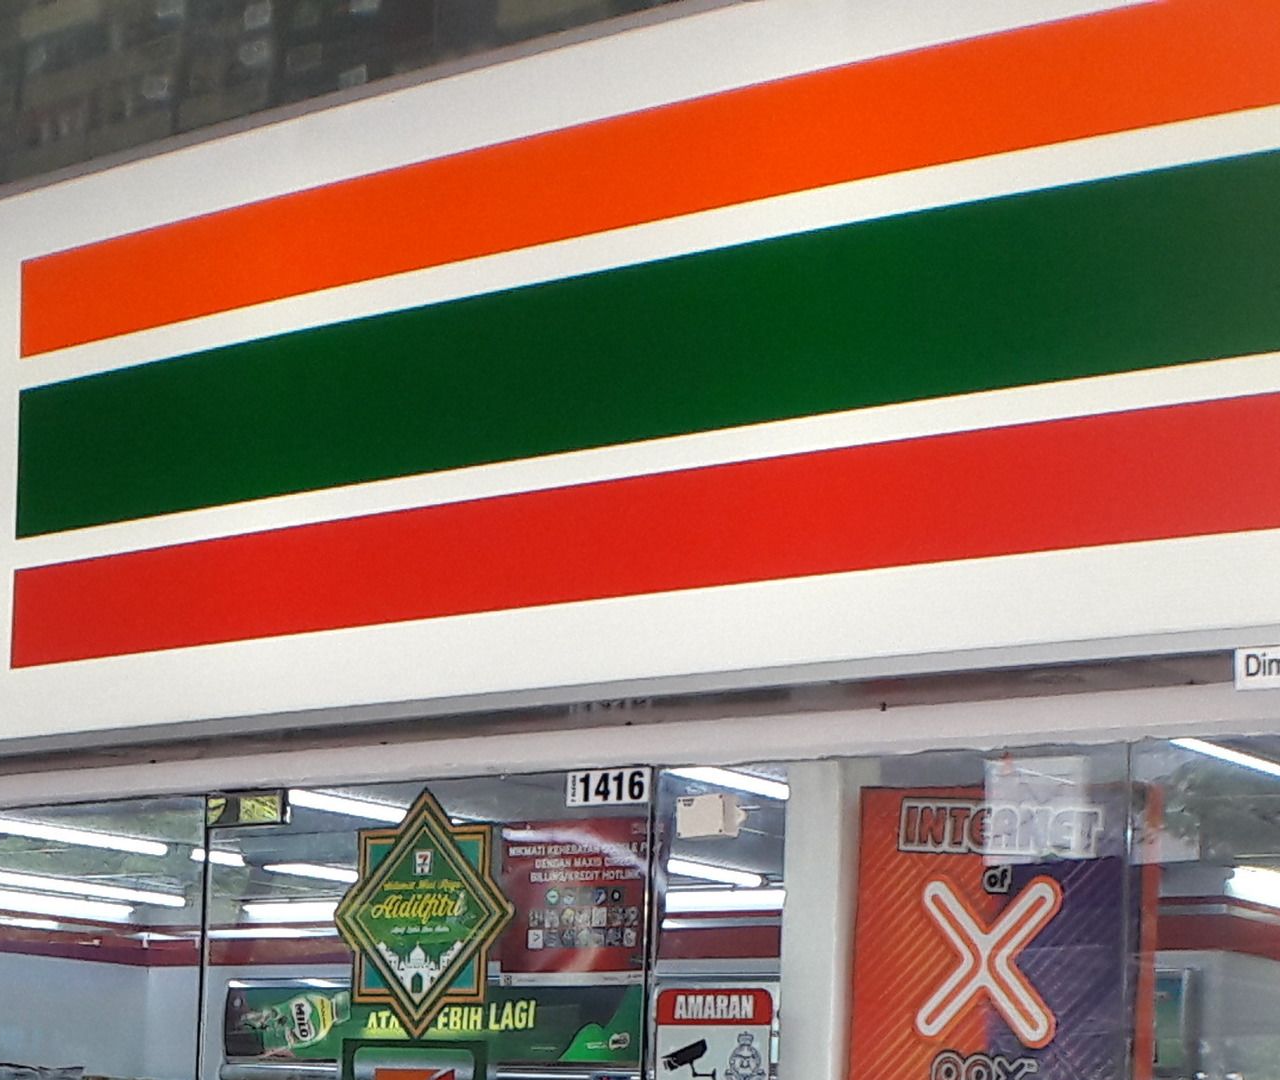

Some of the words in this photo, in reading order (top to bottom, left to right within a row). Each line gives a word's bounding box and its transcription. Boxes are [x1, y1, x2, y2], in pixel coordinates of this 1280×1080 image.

[579, 770, 645, 802] 1416
[985, 866, 1010, 891] of
[916, 880, 1058, 1044] X
[295, 1002, 309, 1038] MILO
[431, 1005, 482, 1030] EBIH
[488, 999, 536, 1031] LAGI
[674, 994, 754, 1020] AMARAN
